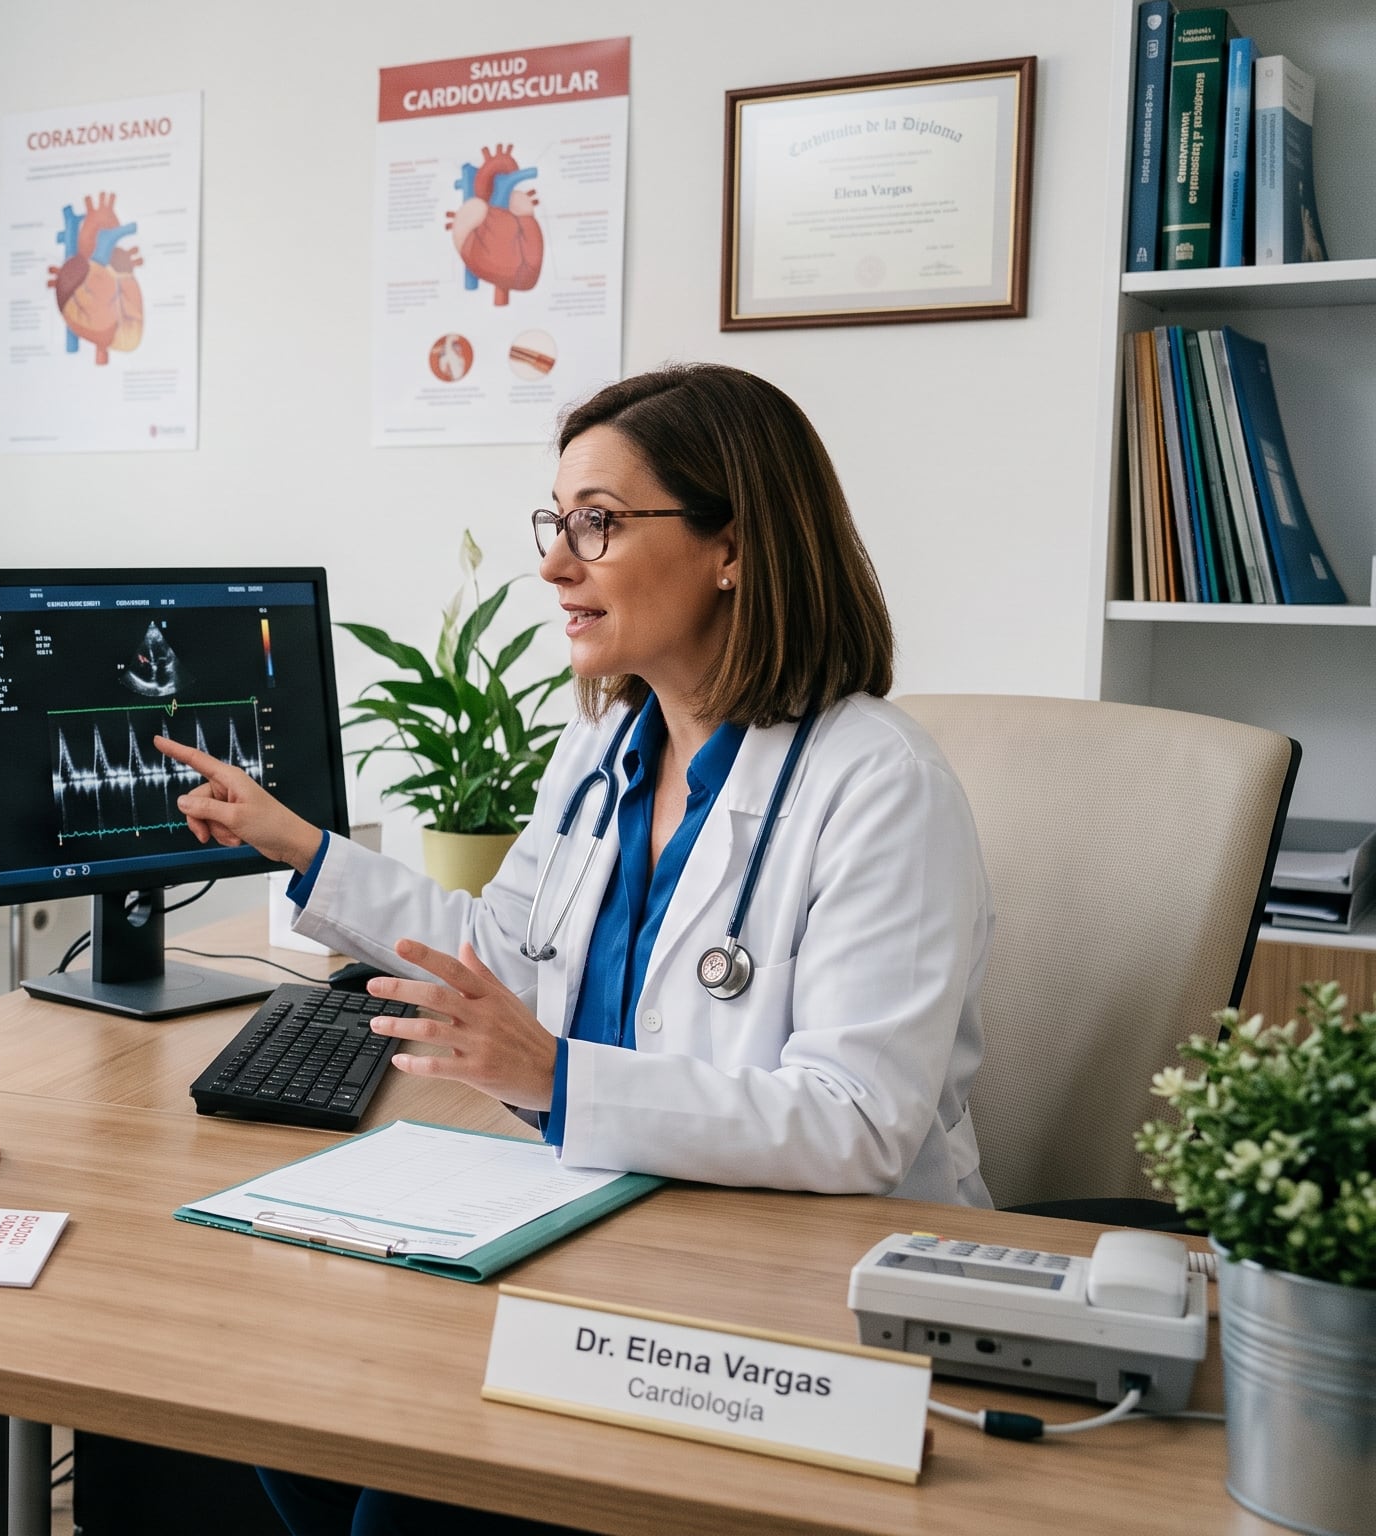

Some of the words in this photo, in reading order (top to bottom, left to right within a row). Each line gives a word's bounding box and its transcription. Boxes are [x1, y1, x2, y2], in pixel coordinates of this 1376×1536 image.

[470, 57, 527, 80] SALUD
[403, 70, 599, 112] CARDIOVASCULAR
[26, 121, 114, 151] CORAZÓN
[118, 116, 172, 140] SANO
[866, 119, 880, 133] de
[884, 117, 897, 131] la
[902, 116, 963, 143] Diploma
[833, 186, 868, 200] Elena
[871, 184, 913, 199] Vargas
[575, 1326, 615, 1358] Dr.
[626, 1336, 710, 1375] Elena
[723, 1353, 832, 1397] Vargas
[627, 1376, 766, 1423] Cardiología
